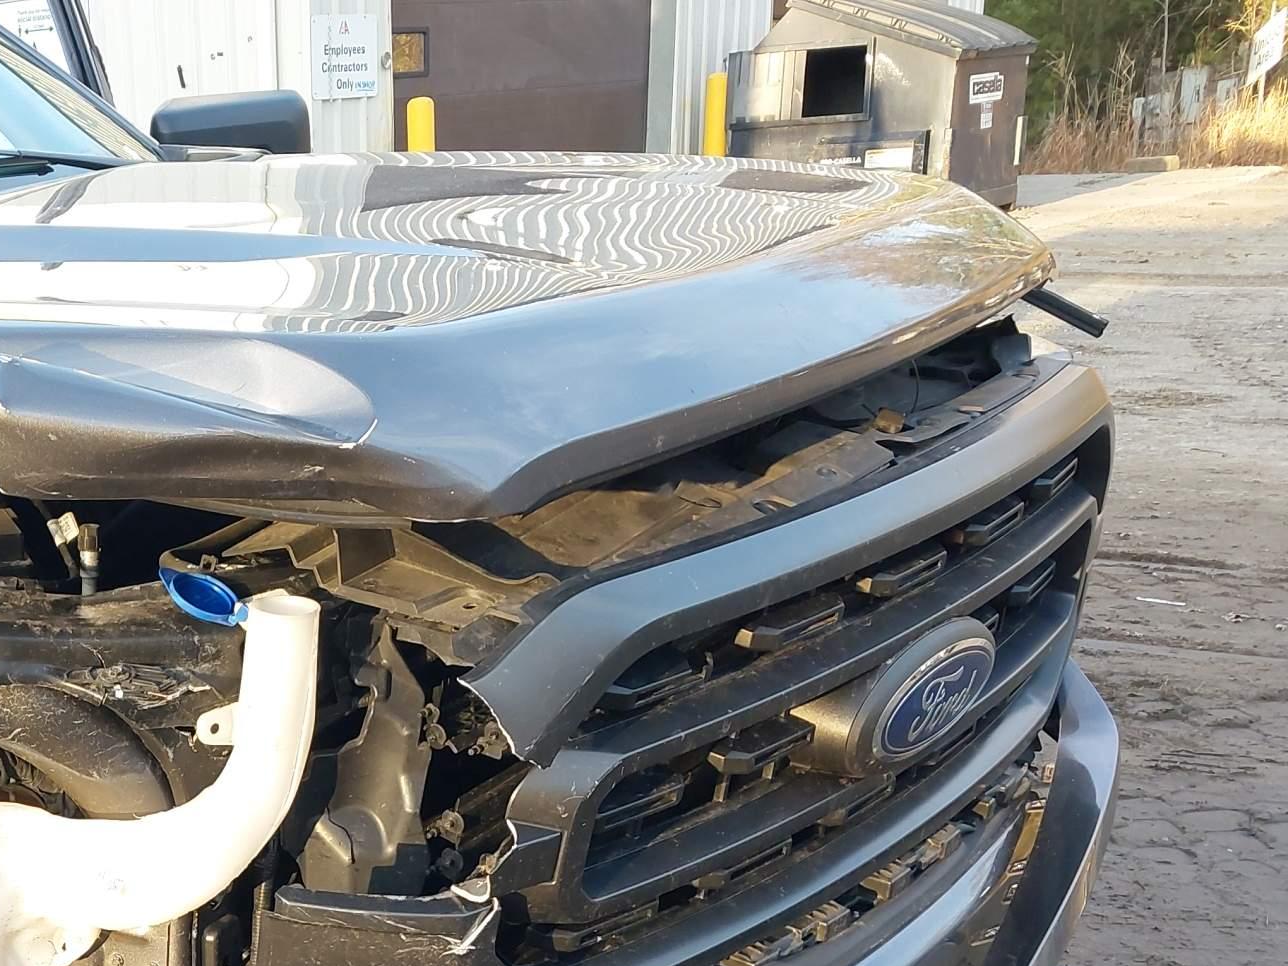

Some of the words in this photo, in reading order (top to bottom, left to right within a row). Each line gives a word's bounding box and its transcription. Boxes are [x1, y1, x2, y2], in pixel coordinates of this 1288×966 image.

[324, 43, 366, 57] Employees
[321, 62, 368, 73] Contractors
[336, 77, 354, 92] Only
[907, 665, 977, 742] Ford
